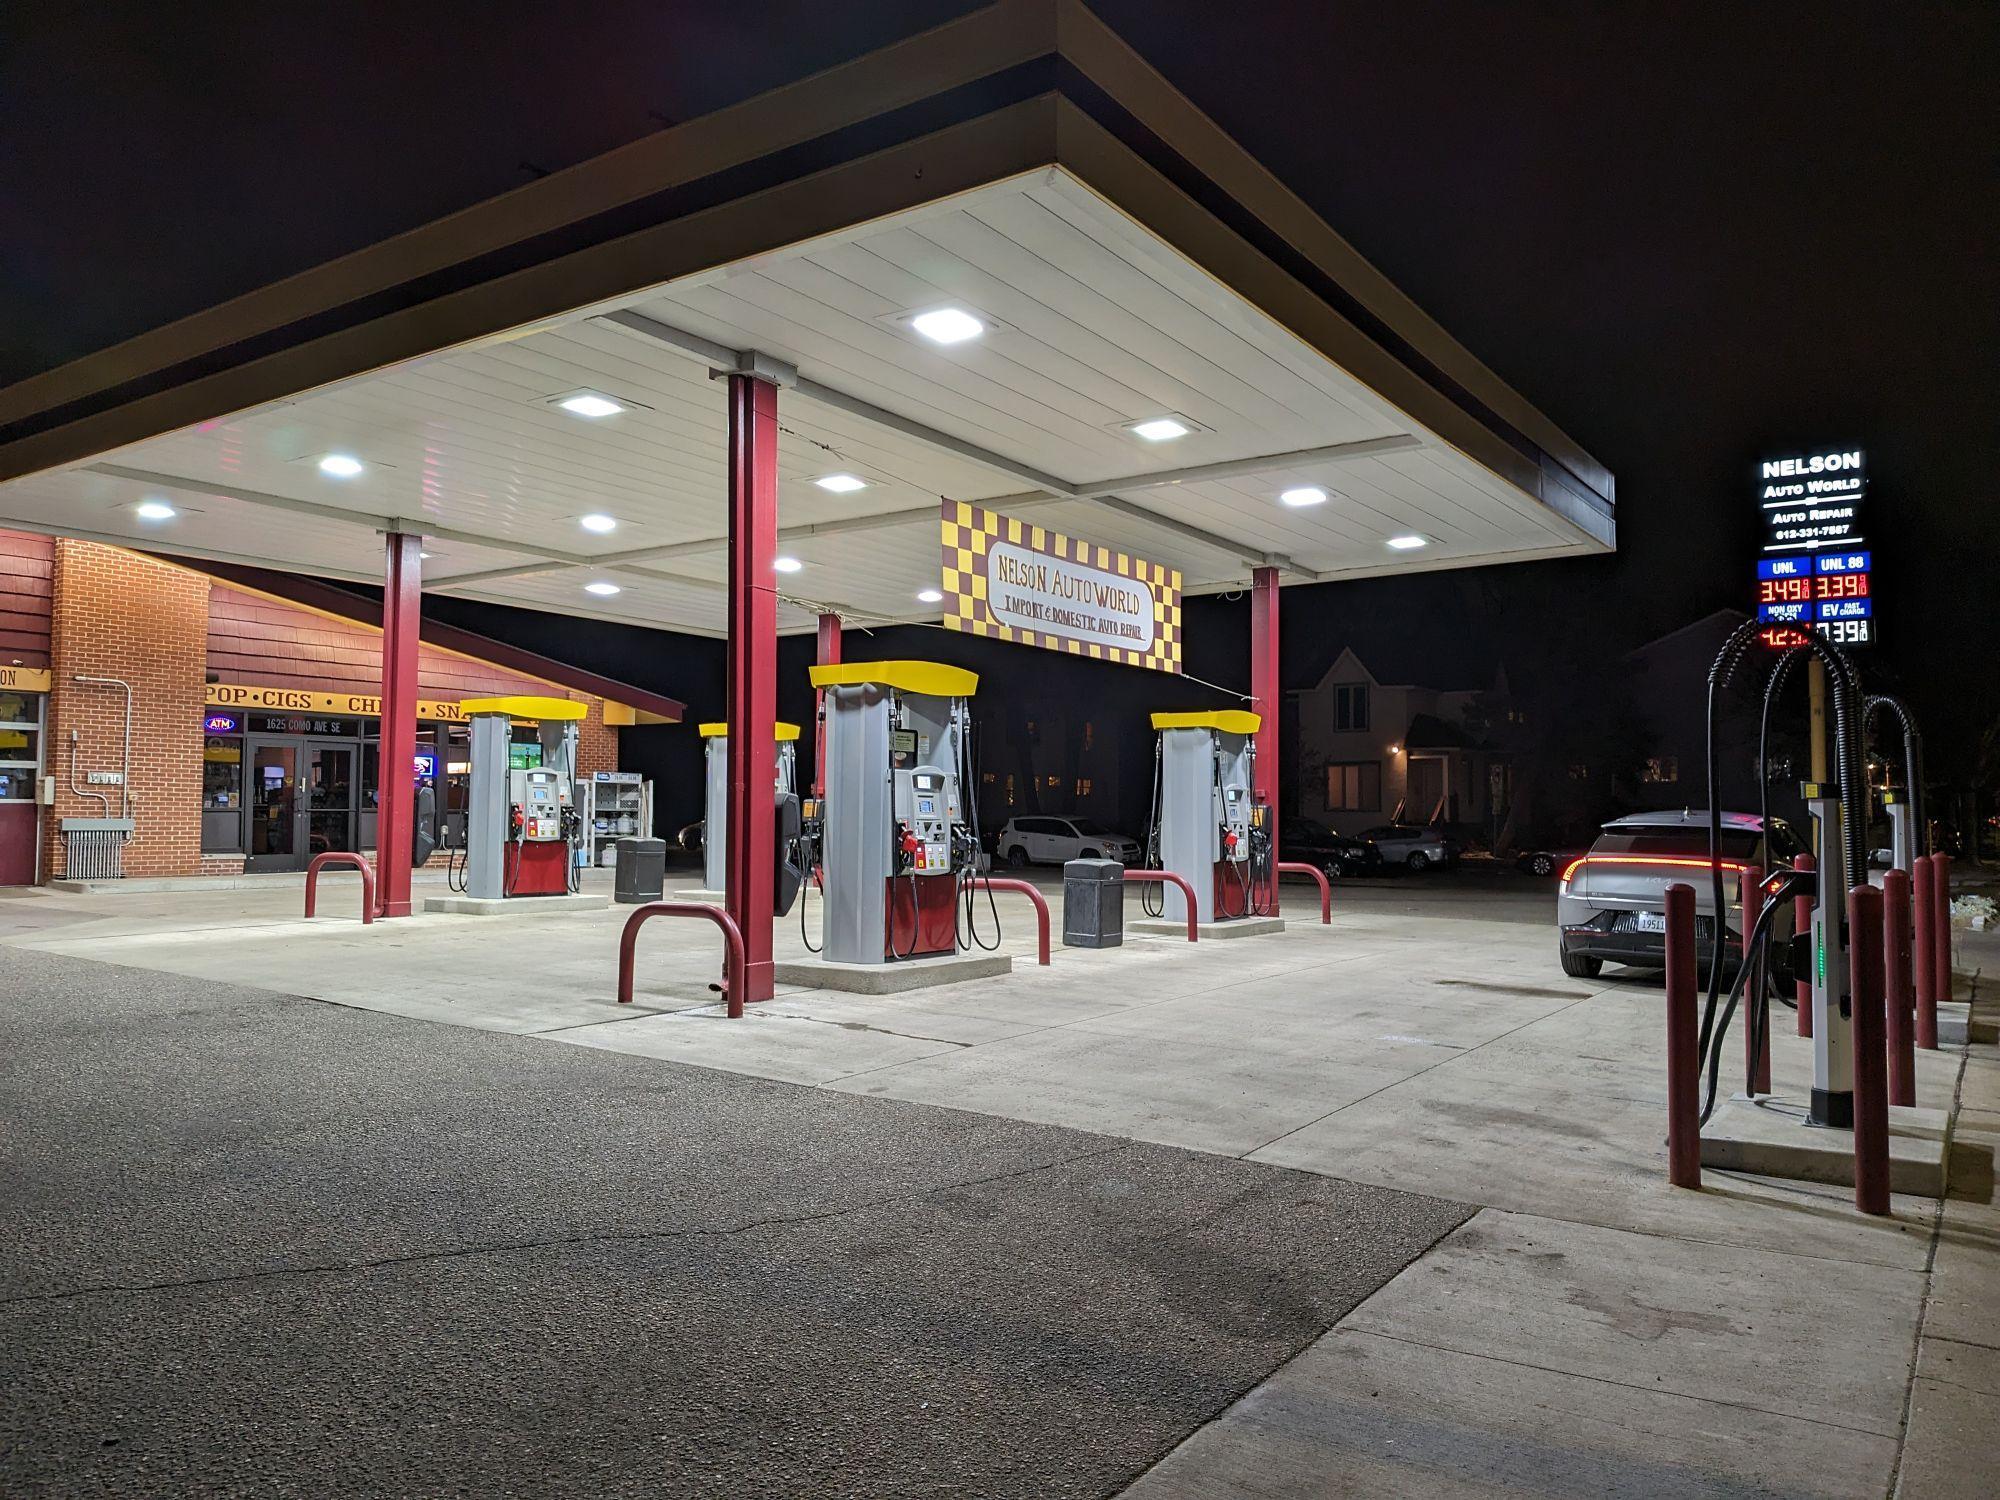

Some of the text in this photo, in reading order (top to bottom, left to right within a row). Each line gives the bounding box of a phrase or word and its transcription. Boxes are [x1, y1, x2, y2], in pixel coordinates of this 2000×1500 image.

[1762, 452, 1860, 479] NELSON
[1763, 478, 1860, 499] AUTO WORLD
[1772, 507, 1853, 525] AUTO REPAIR
[1772, 561, 1797, 575] UNL
[1821, 556, 1864, 571] UNL 88
[998, 554, 1140, 616] NELSON AUTO WORLD
[1005, 594, 1044, 619] IMPORT
[1052, 606, 1097, 631] DOMESTIC
[1098, 618, 1119, 634] AUTO
[1120, 622, 1142, 640] REPAIR
[1768, 604, 1803, 615] NON OXY
[1822, 603, 1840, 617] EV
[205, 686, 248, 703] POP
[262, 690, 312, 709] CIGS
[210, 719, 231, 730] ATM
[266, 718, 341, 733] 1625 COMO AVE SE
